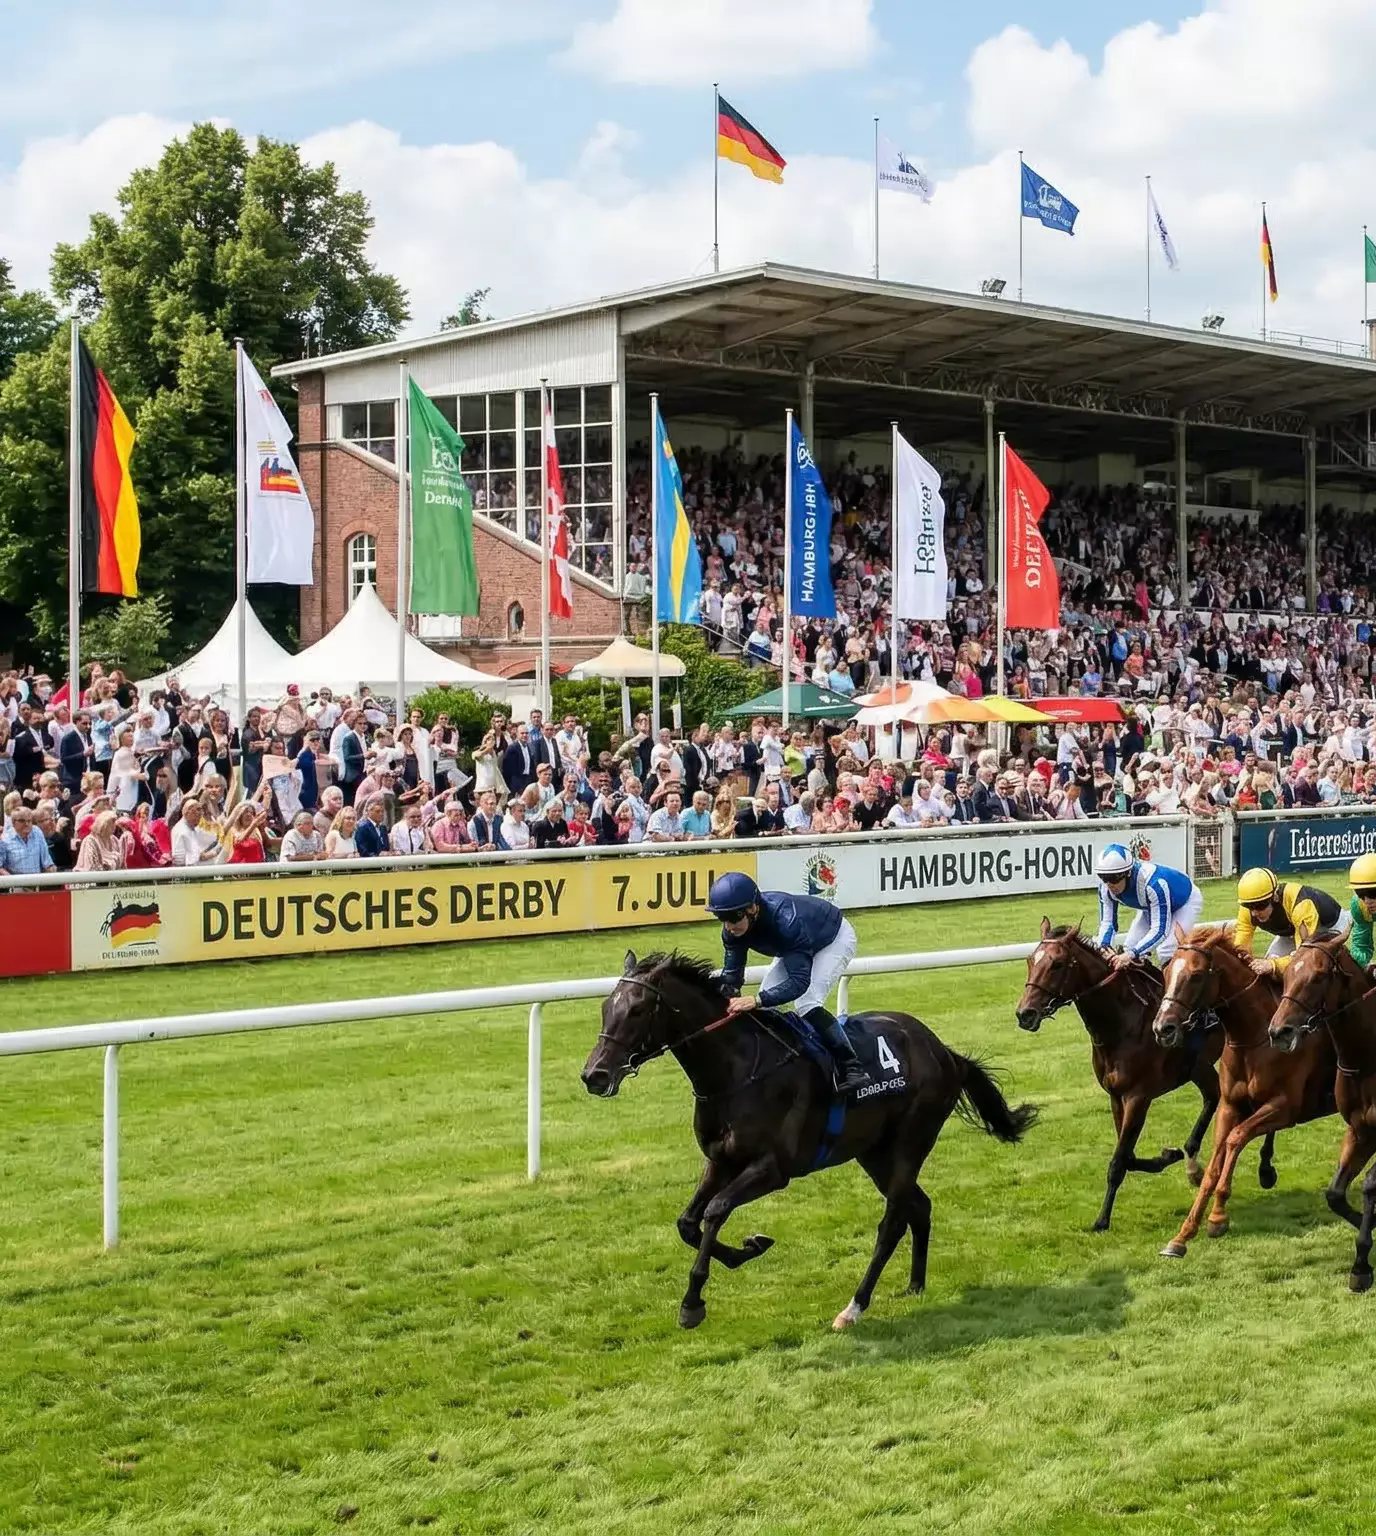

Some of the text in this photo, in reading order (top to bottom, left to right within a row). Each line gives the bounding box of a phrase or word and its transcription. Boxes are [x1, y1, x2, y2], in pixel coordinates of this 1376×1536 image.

[880, 844, 1093, 892] HAMBURG-HORN
[202, 886, 439, 943] DEUTSCHES
[450, 878, 566, 924] DERBY
[612, 875, 639, 912] 7.
[877, 1035, 901, 1074] 4
